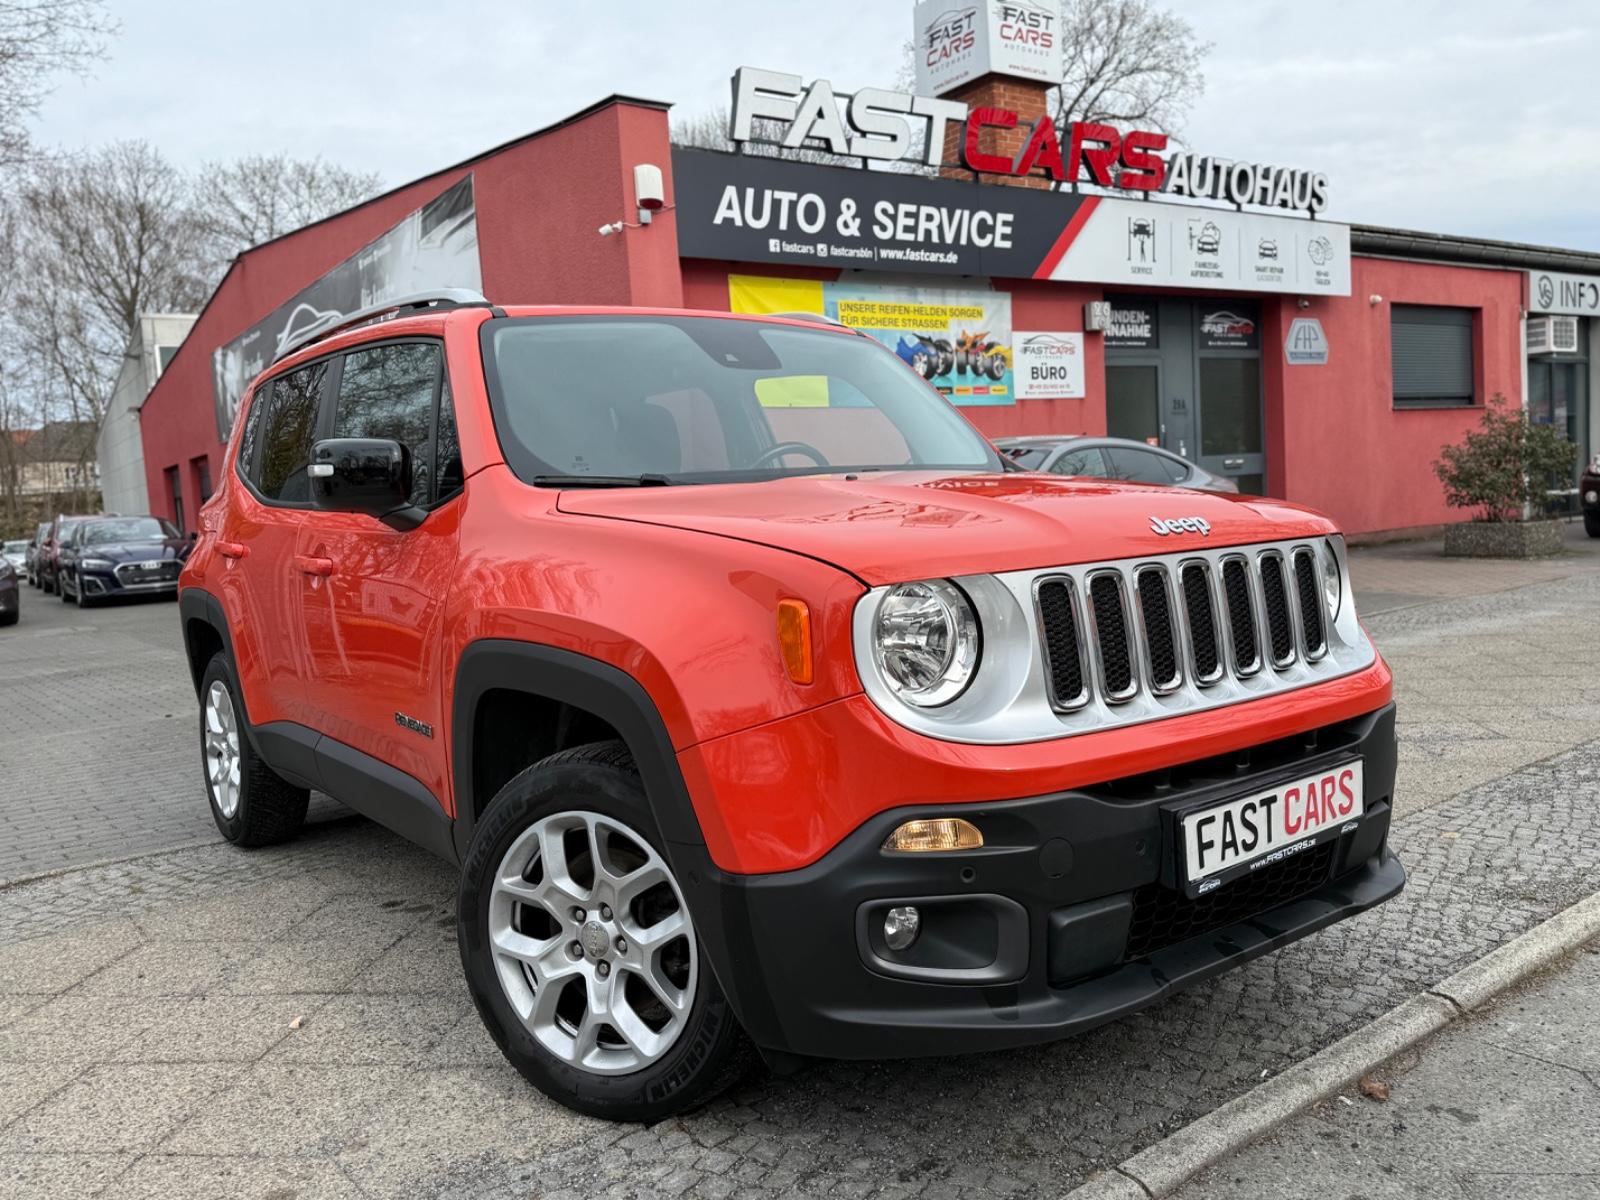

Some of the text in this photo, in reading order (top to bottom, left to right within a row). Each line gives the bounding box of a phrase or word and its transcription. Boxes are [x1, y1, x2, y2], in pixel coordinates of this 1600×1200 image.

[929, 11, 976, 48] FAST
[1002, 6, 1054, 30] FAST
[1000, 24, 1053, 48] CARS
[926, 30, 975, 67] CARS
[1166, 152, 1329, 214] AUTOHAUS
[713, 184, 1014, 248] AUTO & SERVICE
[781, 241, 815, 255] fastcars
[880, 246, 958, 264] www.fastcars.de
[840, 302, 983, 318] UNSERE REIFEN-HELDEN SORGEN
[840, 314, 948, 329] FÜR SICHERE STRASSEN!
[1108, 309, 1150, 323] UNDEN-
[1031, 362, 1067, 380] BÜRO
[1148, 516, 1211, 537] Jeep
